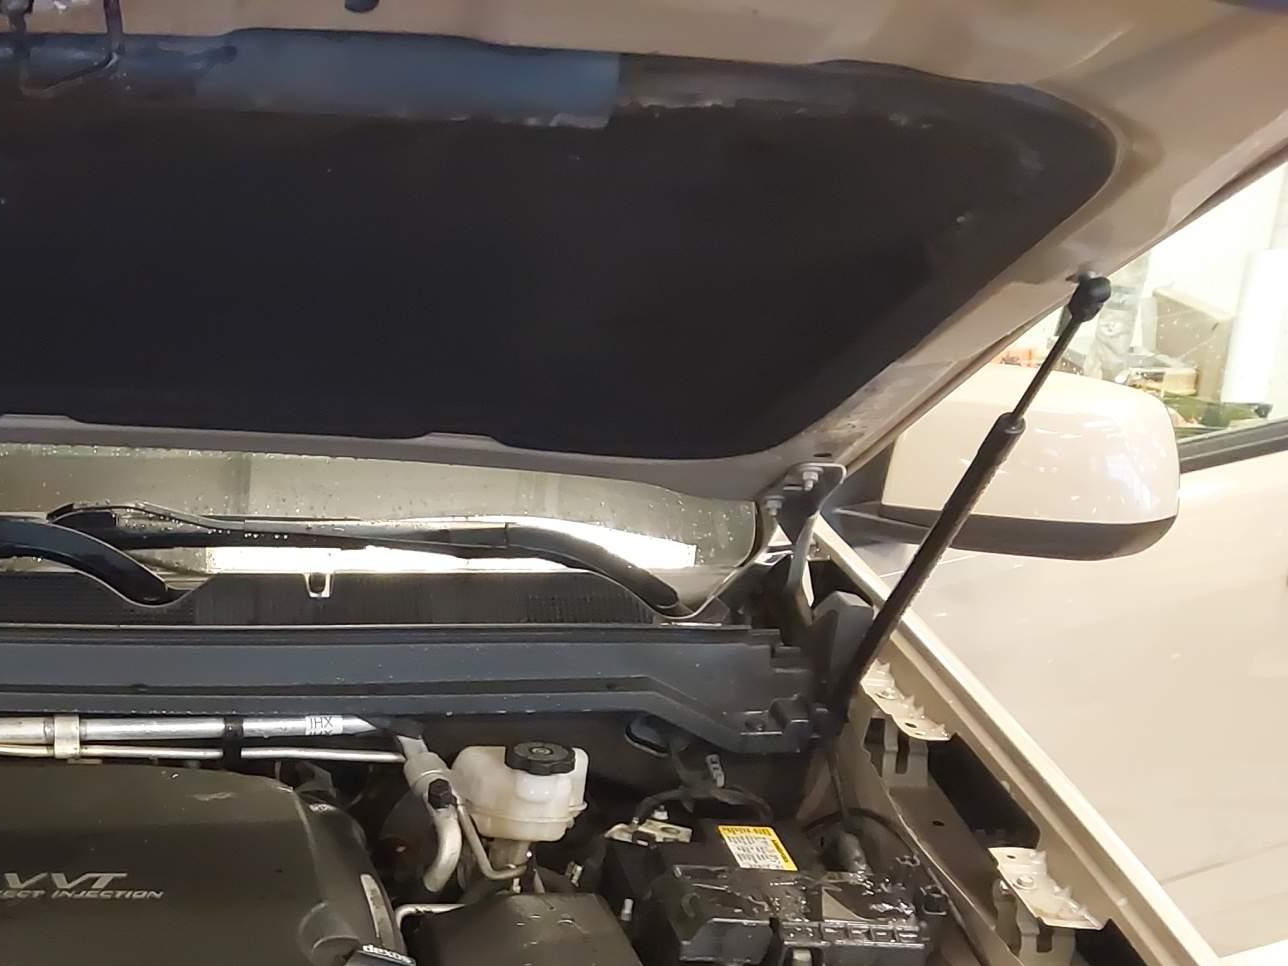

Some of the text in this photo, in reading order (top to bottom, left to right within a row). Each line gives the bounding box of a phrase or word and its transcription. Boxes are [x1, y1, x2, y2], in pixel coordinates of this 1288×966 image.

[3, 872, 128, 889] VVT
[51, 890, 165, 900] INJECTION
[362, 944, 412, 963] dexos
